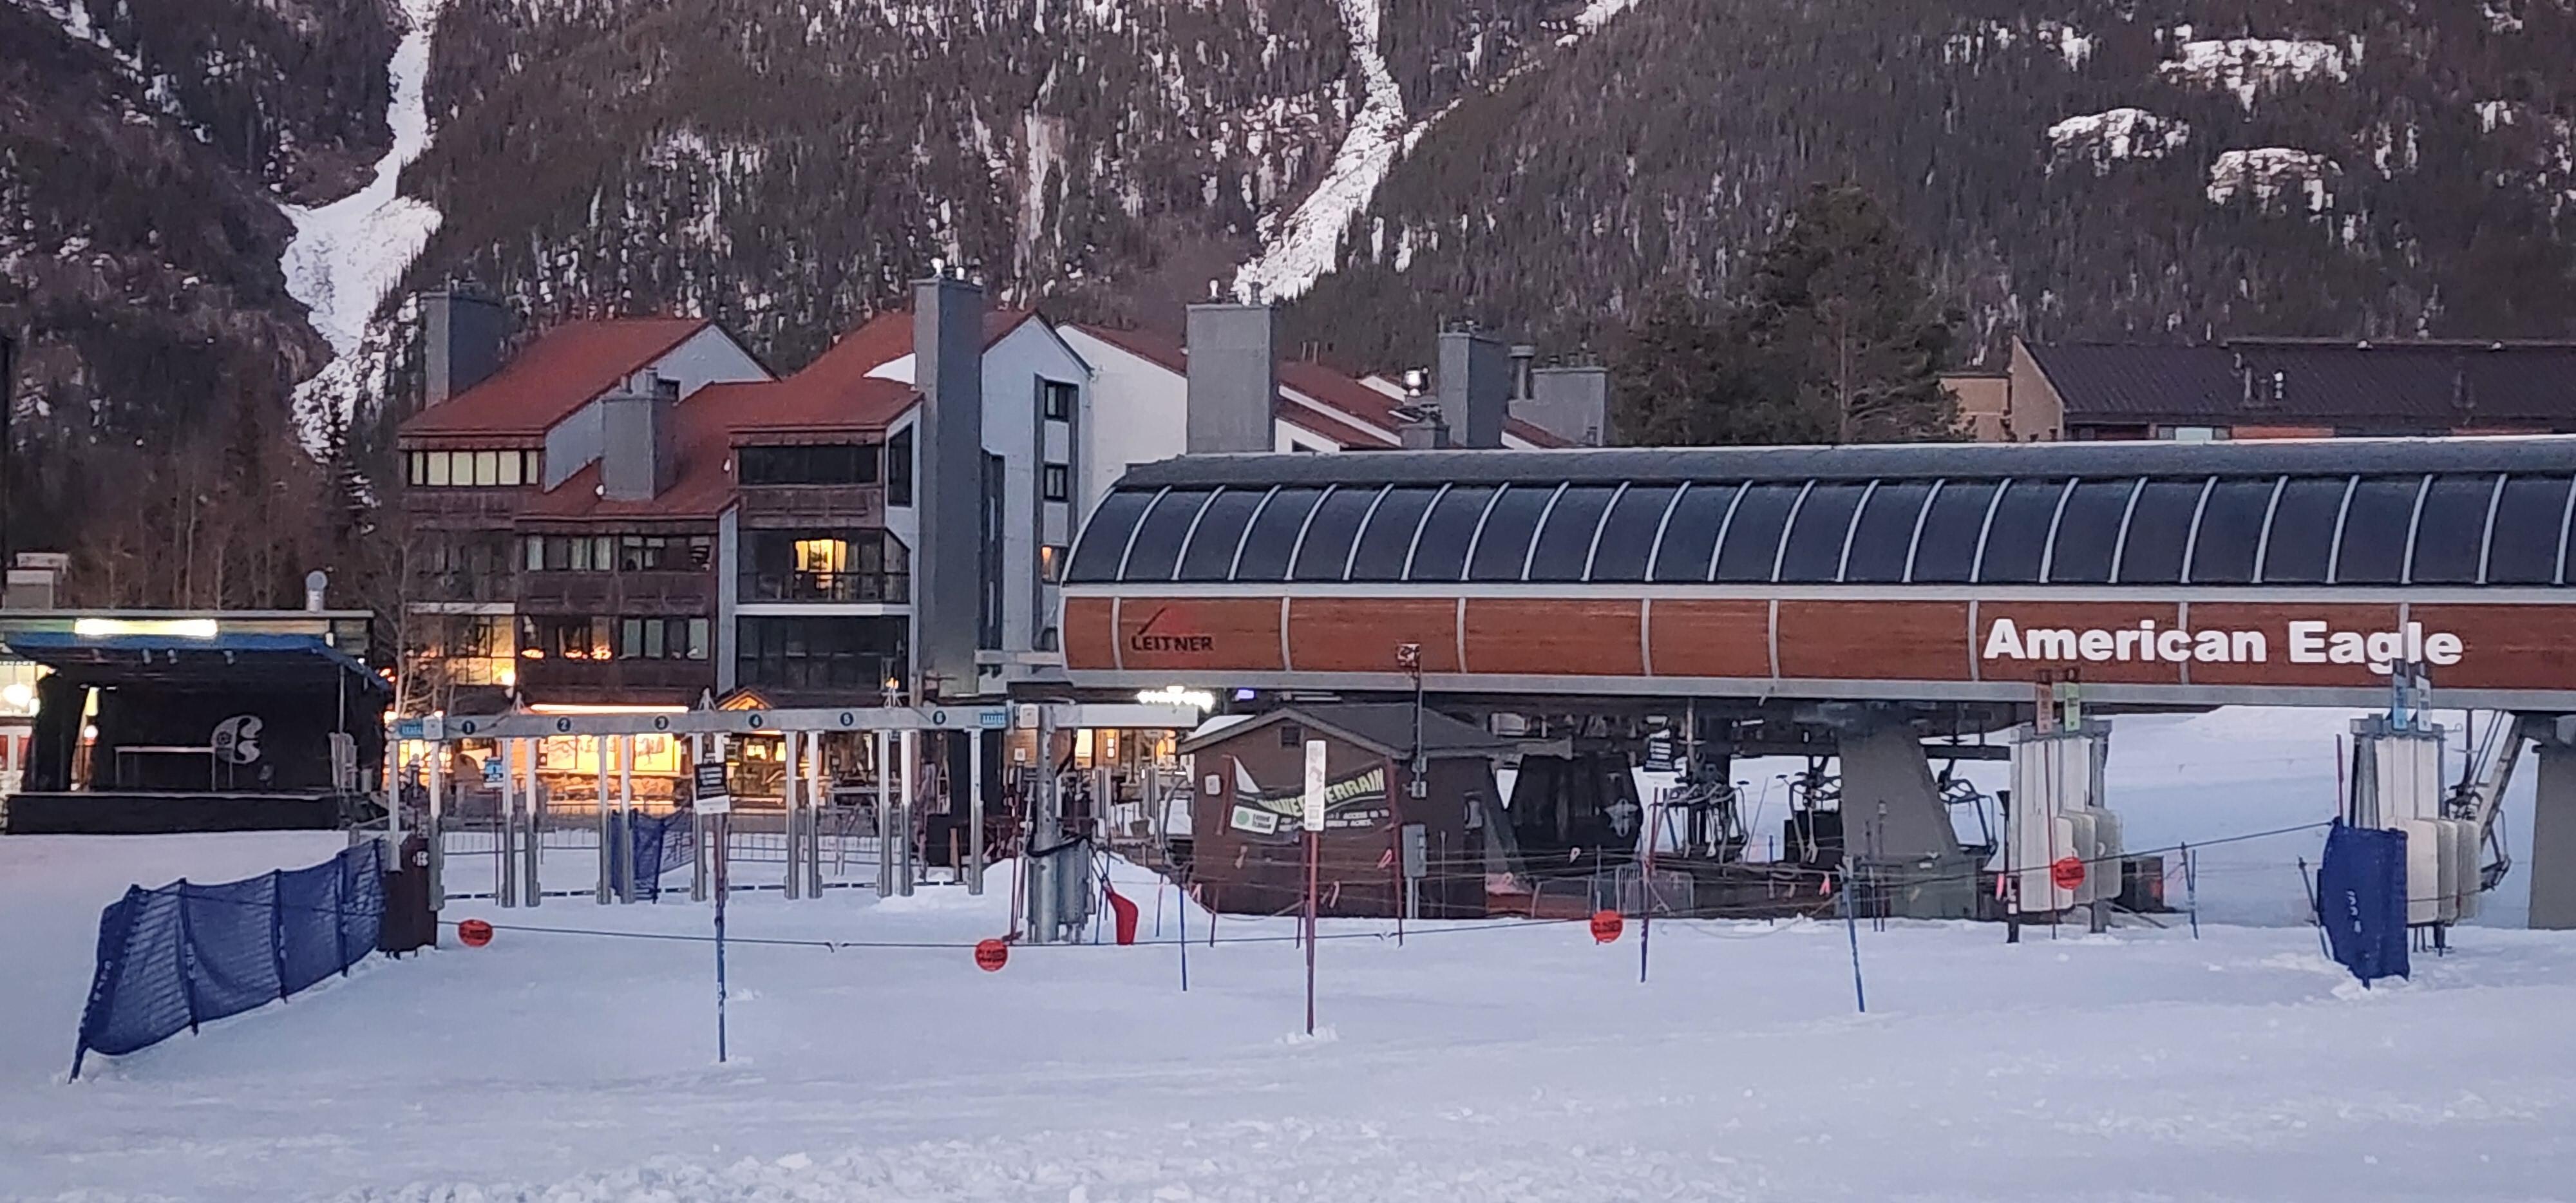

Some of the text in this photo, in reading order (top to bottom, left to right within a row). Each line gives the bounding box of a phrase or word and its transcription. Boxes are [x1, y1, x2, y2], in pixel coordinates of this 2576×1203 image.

[1132, 636, 1214, 651] LEITNER
[1985, 620, 2461, 673] American Eagle
[1325, 768, 1385, 804] ERRAIN
